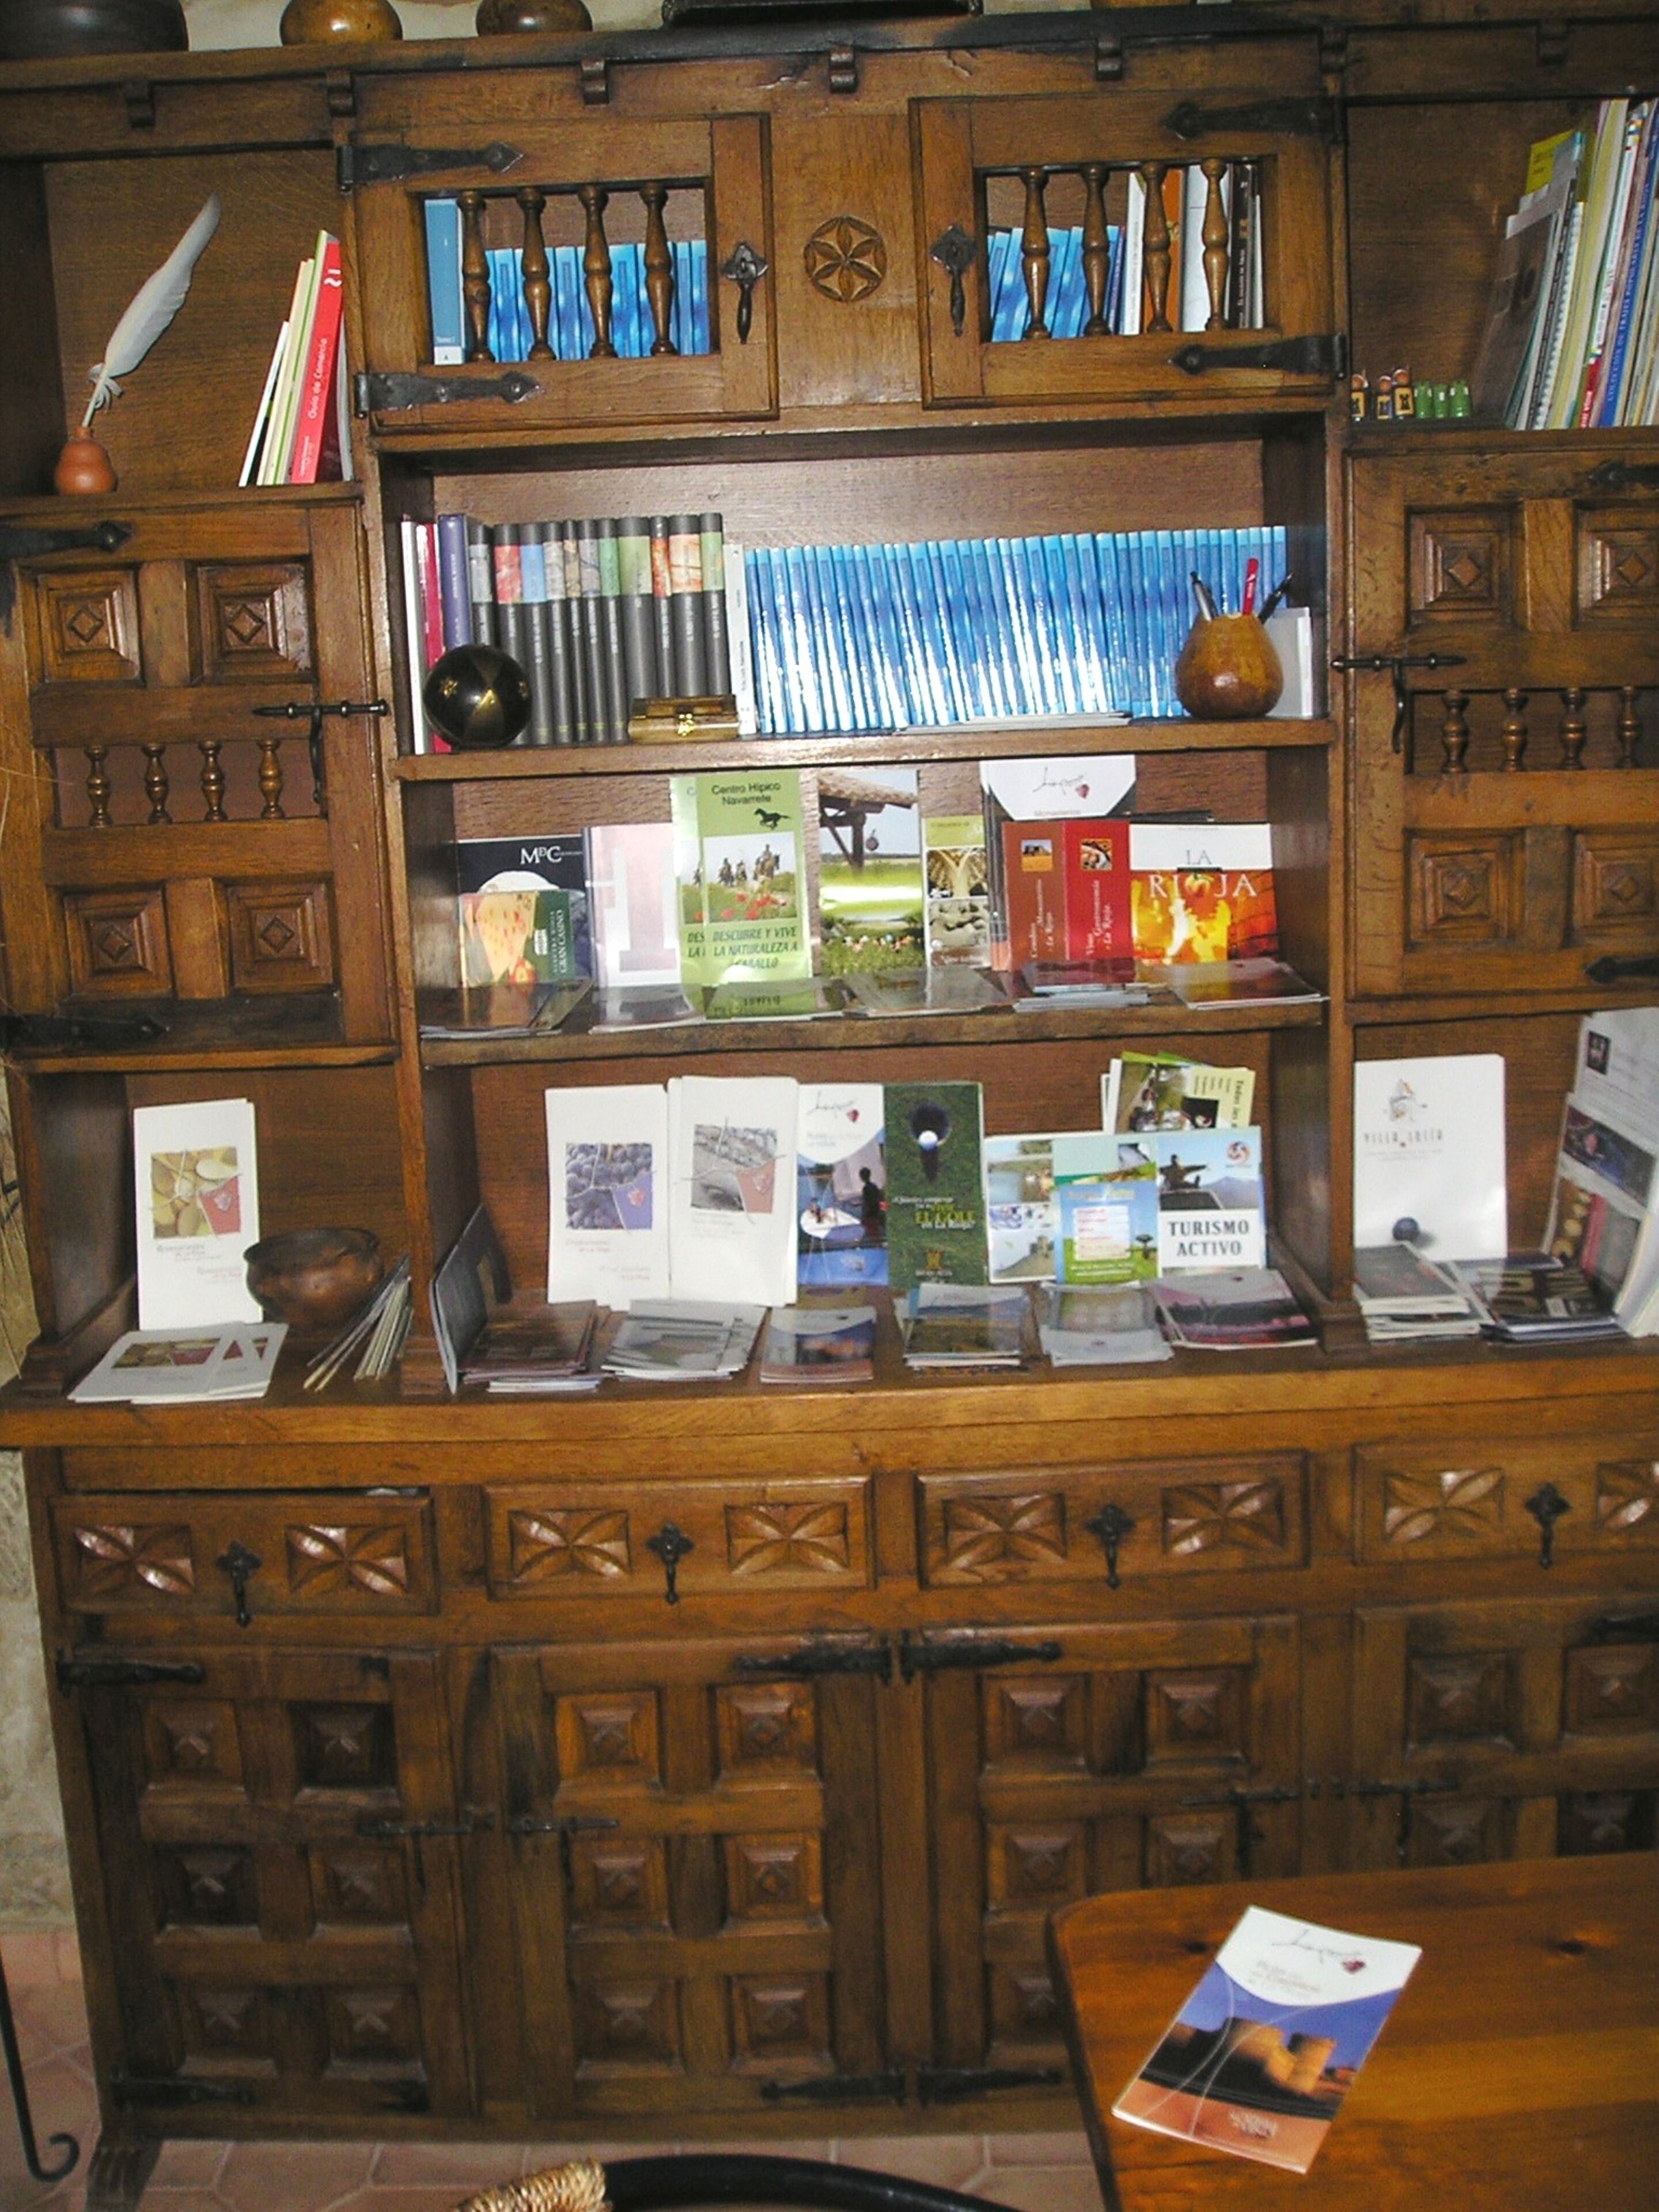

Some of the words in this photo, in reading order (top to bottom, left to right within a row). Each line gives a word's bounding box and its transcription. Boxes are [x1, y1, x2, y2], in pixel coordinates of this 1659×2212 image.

[711, 785, 747, 795] Centro
[722, 794, 772, 805] Navarrete
[1185, 849, 1213, 865] LA
[556, 909, 566, 946] CASINO
[713, 928, 762, 942] DESCUBRE
[766, 928, 772, 938] Y
[774, 926, 797, 938] VIVE
[714, 946, 725, 957] LA
[728, 942, 789, 956] NATURALEZA
[790, 942, 798, 952] A
[558, 946, 567, 974] GRAN
[1168, 1219, 1249, 1237] TURISMO
[1176, 1240, 1242, 1257] ACTIVO
